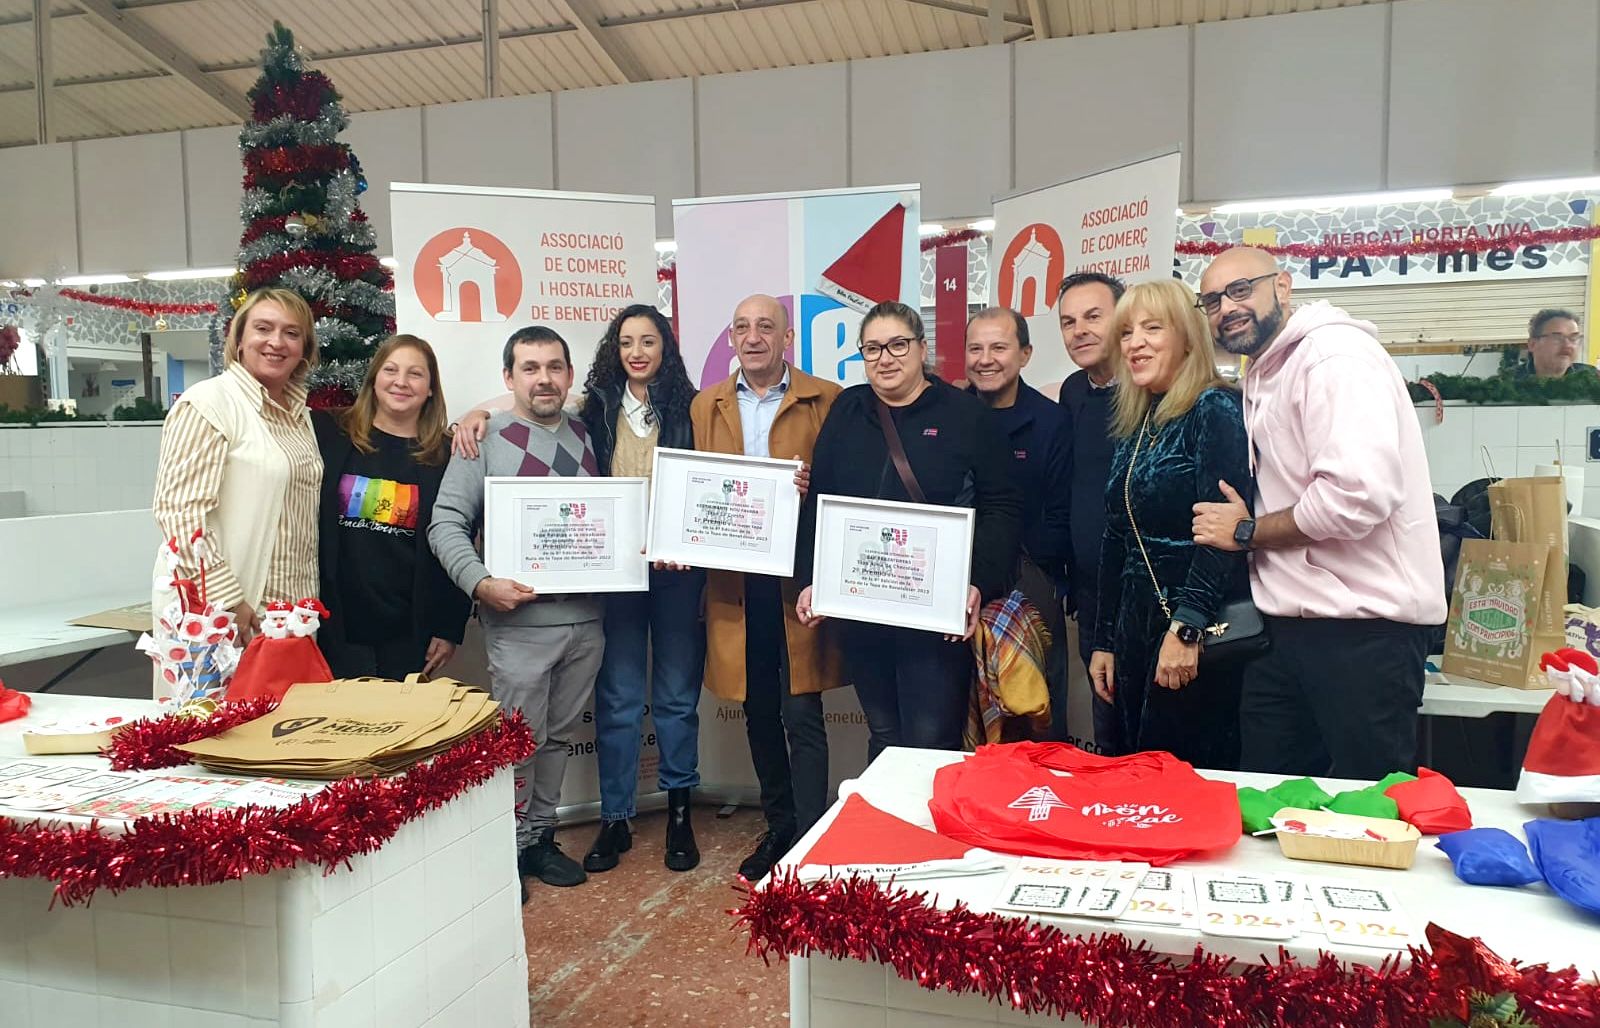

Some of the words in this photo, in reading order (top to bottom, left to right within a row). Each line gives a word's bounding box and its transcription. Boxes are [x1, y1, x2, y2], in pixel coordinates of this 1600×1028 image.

[1081, 196, 1148, 228] ASSOCIACIÓ
[540, 232, 624, 251] ASSOCIACIÓ
[1081, 238, 1095, 254] DE
[1098, 227, 1148, 249] COMERÇ
[1324, 229, 1403, 246] MERCAT
[1412, 225, 1479, 243] HORTA
[1486, 222, 1533, 240] VIVA
[544, 256, 563, 272] DE
[567, 257, 627, 278] COMERÇ
[1082, 254, 1150, 275] HOSTALERIA
[540, 281, 545, 296] I
[549, 281, 634, 299] HOSTALERIA
[943, 277, 957, 292] 14
[531, 305, 549, 321] DE
[1469, 600, 1486, 609] ESTA
[1489, 599, 1519, 616] NAVIDAD
